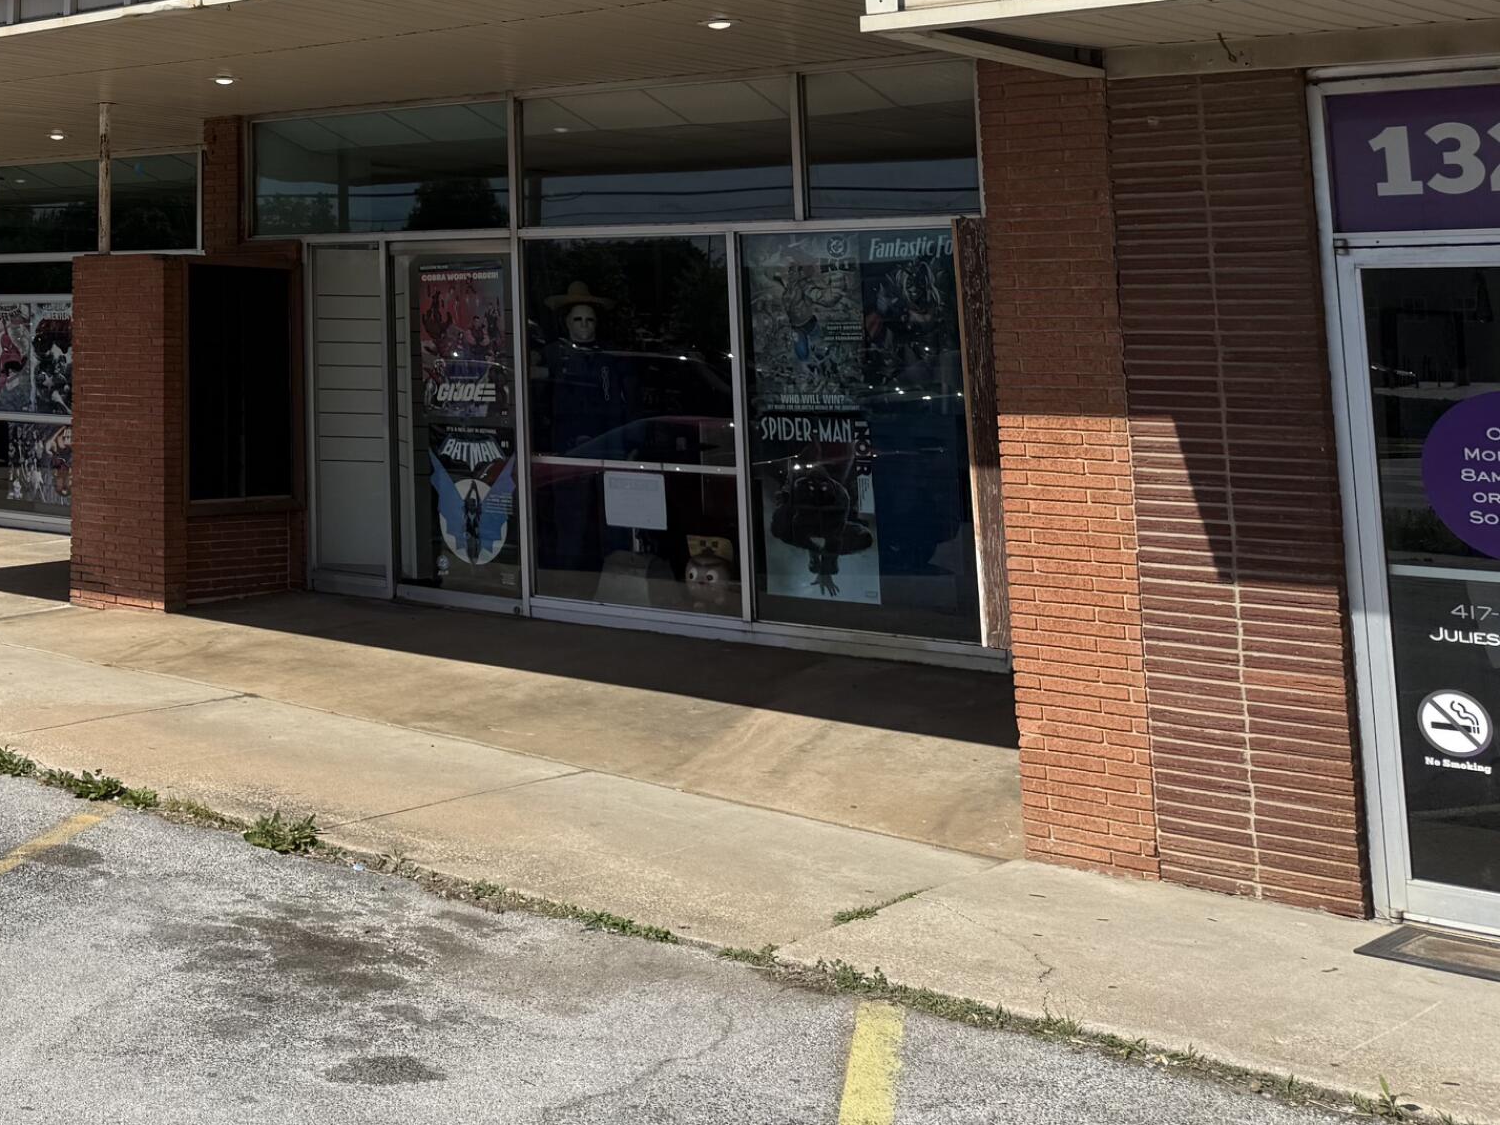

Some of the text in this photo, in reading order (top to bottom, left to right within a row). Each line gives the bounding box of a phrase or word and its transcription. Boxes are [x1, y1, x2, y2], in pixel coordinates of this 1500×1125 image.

[1368, 121, 1500, 197] 13
[868, 237, 936, 261] Fantastic
[780, 394, 845, 404] WHO WILL WIN?
[760, 416, 852, 443] SPIDER-MAN
[440, 438, 504, 472] BATMAN
[1424, 756, 1492, 775] No Smoking
